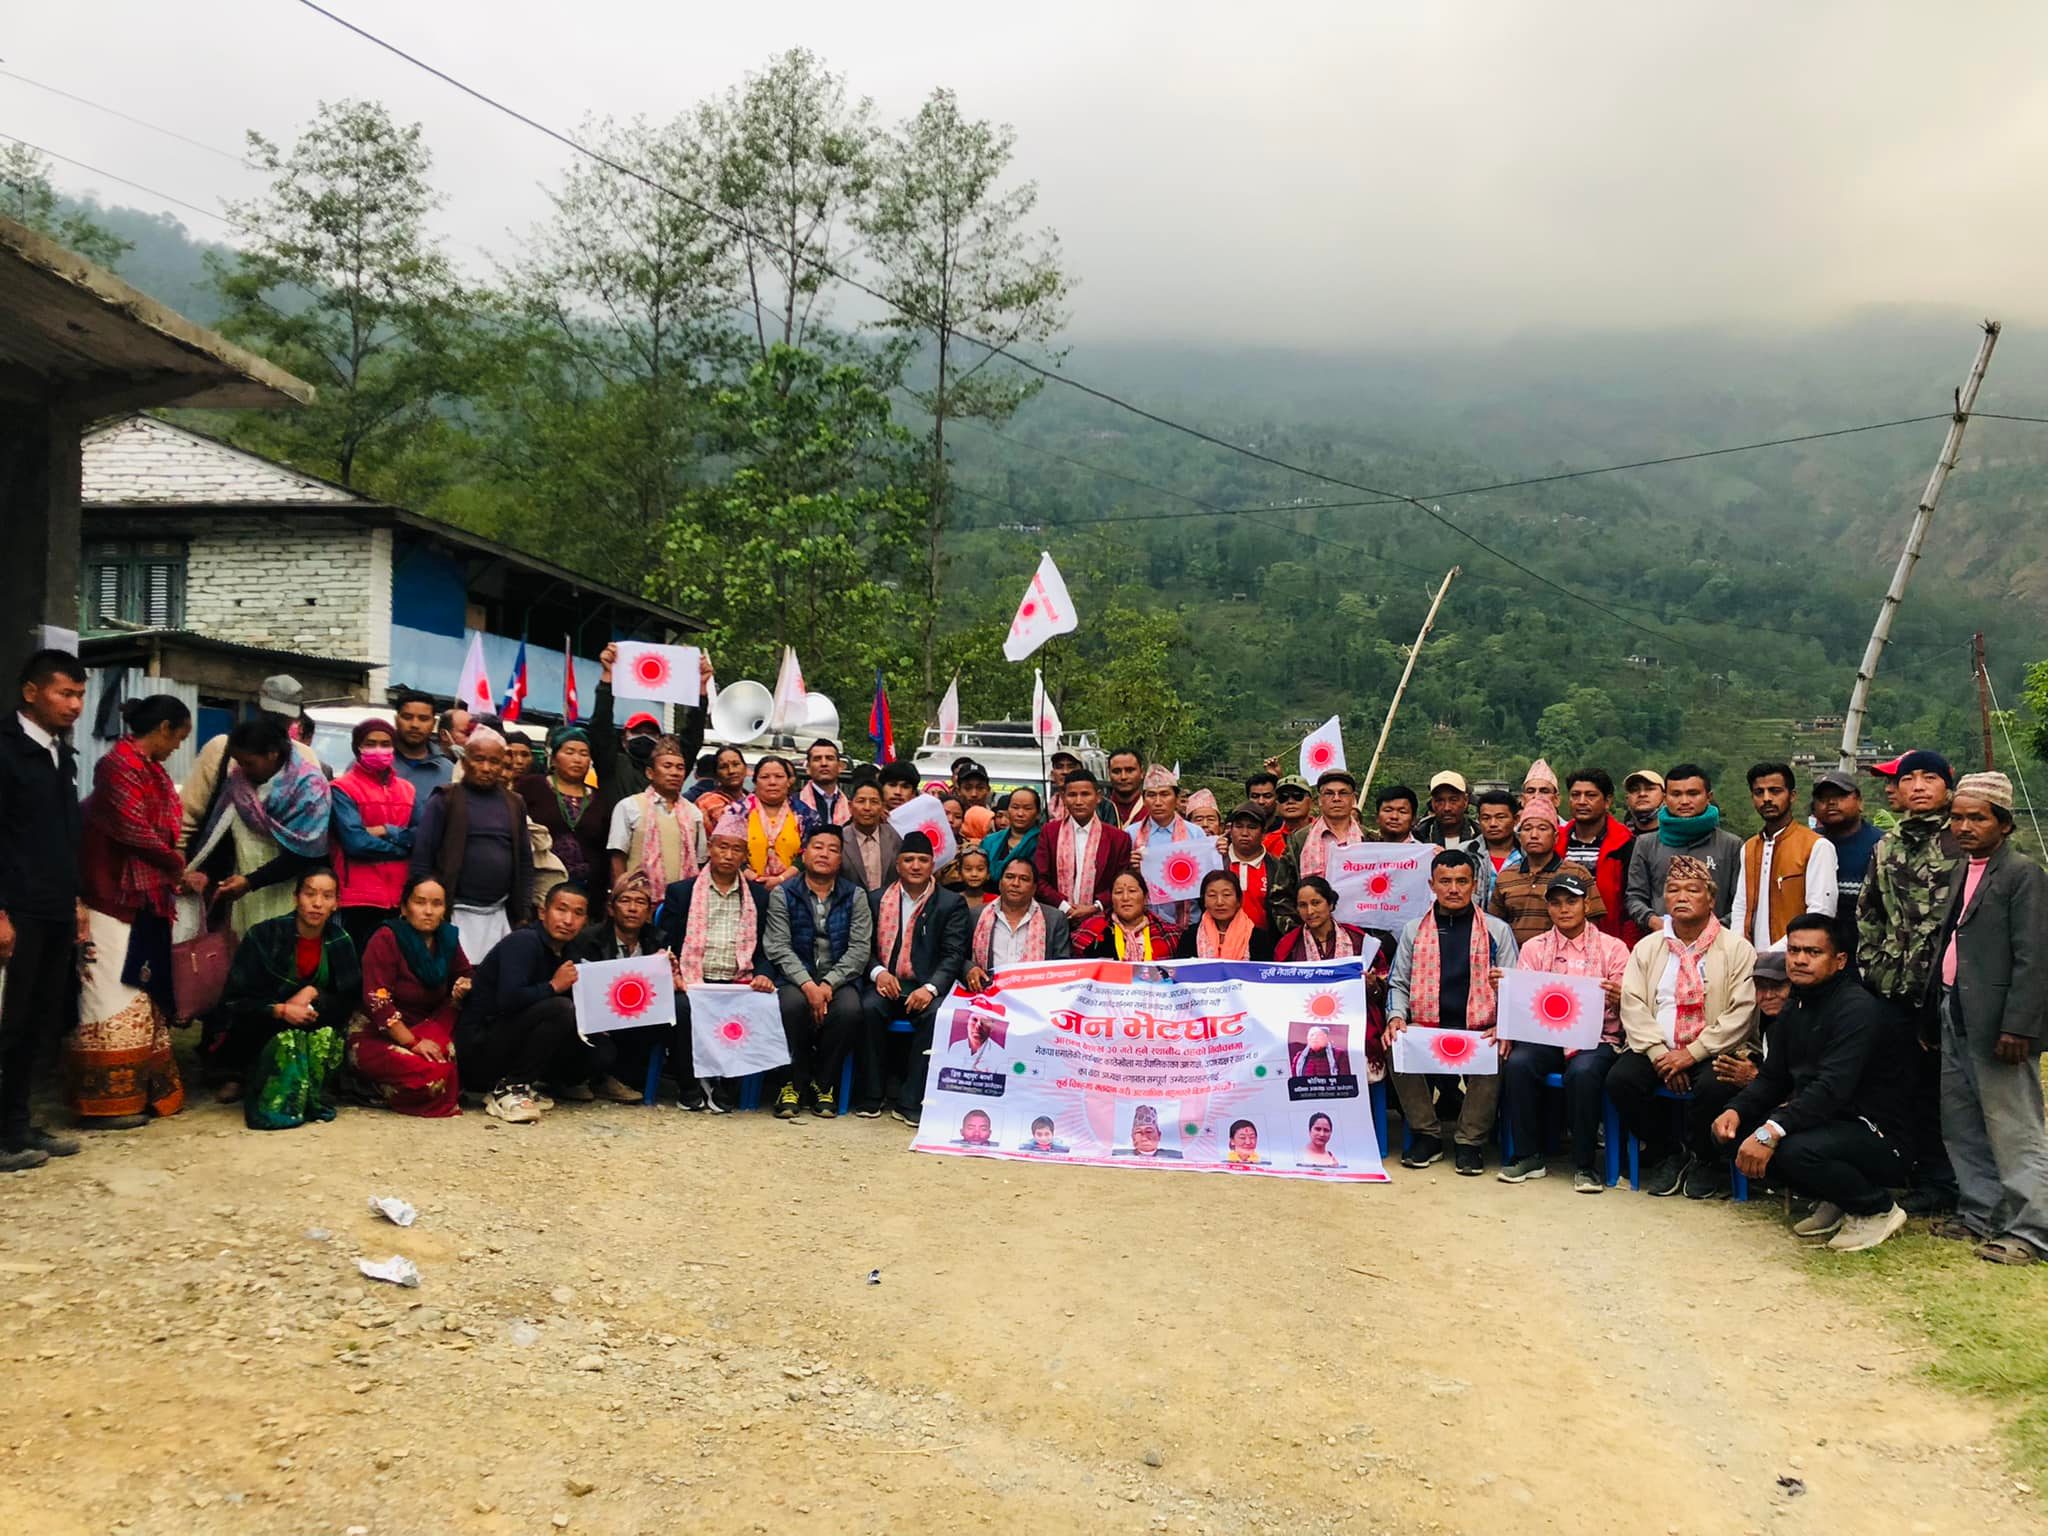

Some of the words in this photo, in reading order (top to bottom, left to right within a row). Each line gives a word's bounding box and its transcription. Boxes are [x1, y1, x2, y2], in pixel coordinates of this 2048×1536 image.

[1343, 859, 1376, 872] नेकपा
[1049, 1009, 1116, 1038] जन
[1123, 1009, 1248, 1042] भेटघाट
